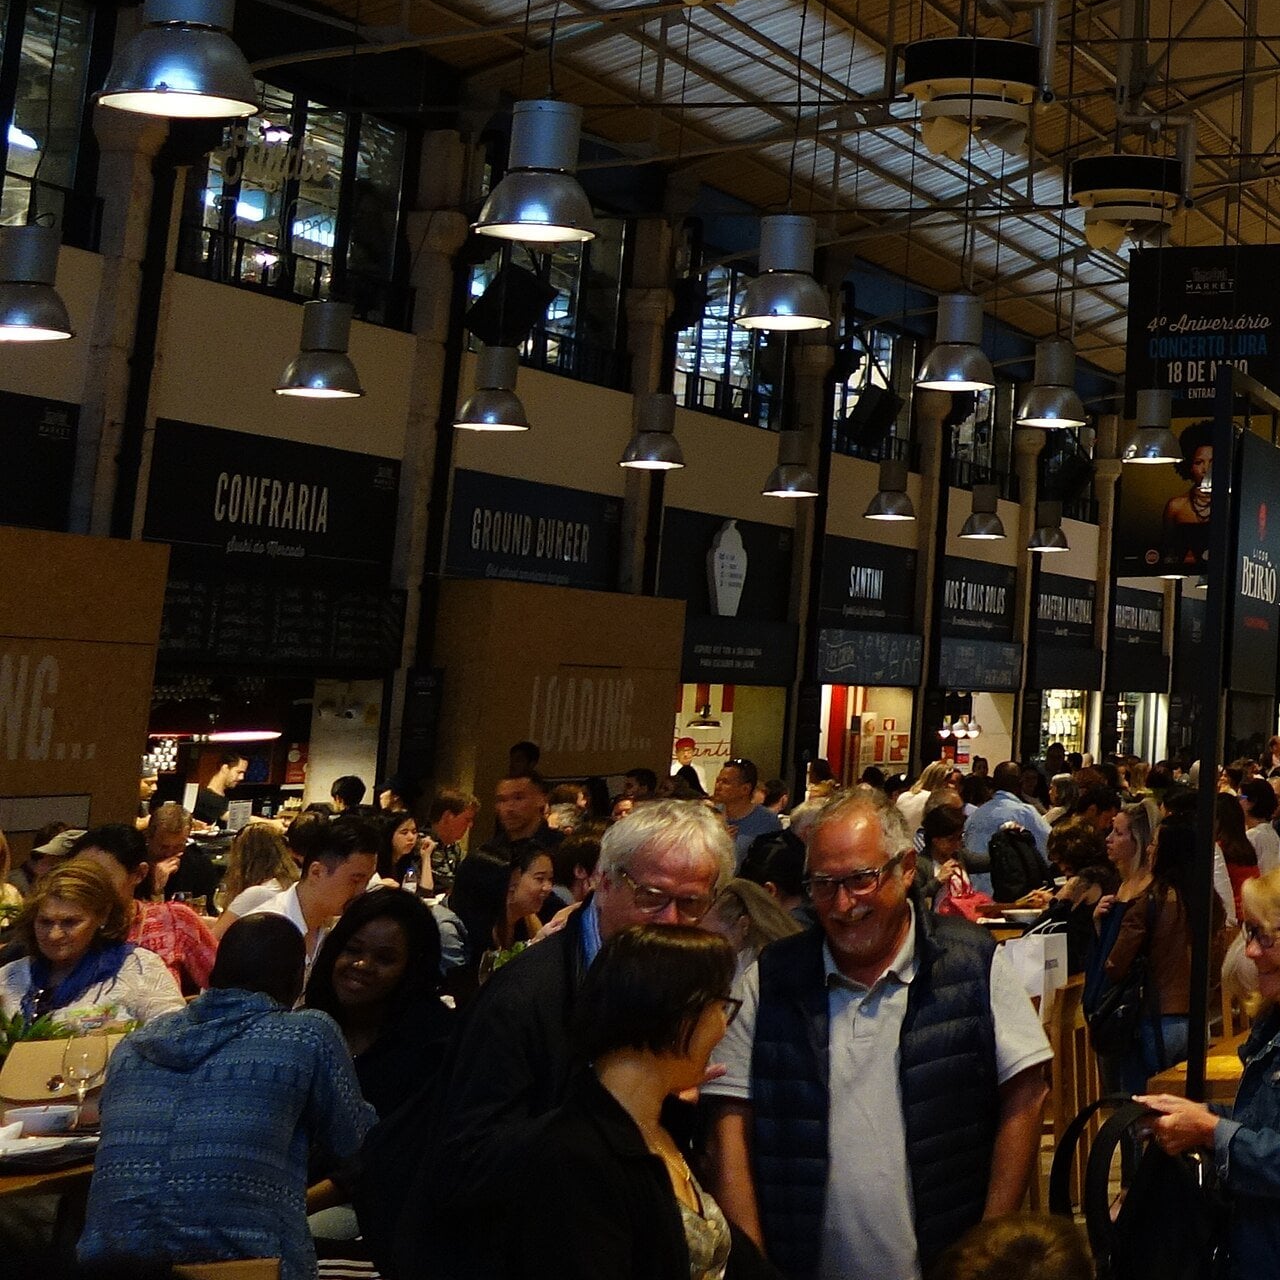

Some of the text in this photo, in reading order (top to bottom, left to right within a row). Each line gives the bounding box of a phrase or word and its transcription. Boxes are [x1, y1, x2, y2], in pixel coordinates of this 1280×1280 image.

[1185, 280, 1235, 291] MARKET
[1169, 313, 1272, 334] Aniversário
[1150, 332, 1269, 359] CONCERTO LURA
[1167, 361, 1184, 384] 18
[1187, 360, 1207, 383] DE
[1188, 387, 1217, 399] ENTRAD
[213, 471, 330, 534] CONFRARIA
[470, 506, 591, 564] GROUND BURGER
[849, 565, 885, 600] SANTINI
[1240, 555, 1278, 605] BEIRÃO
